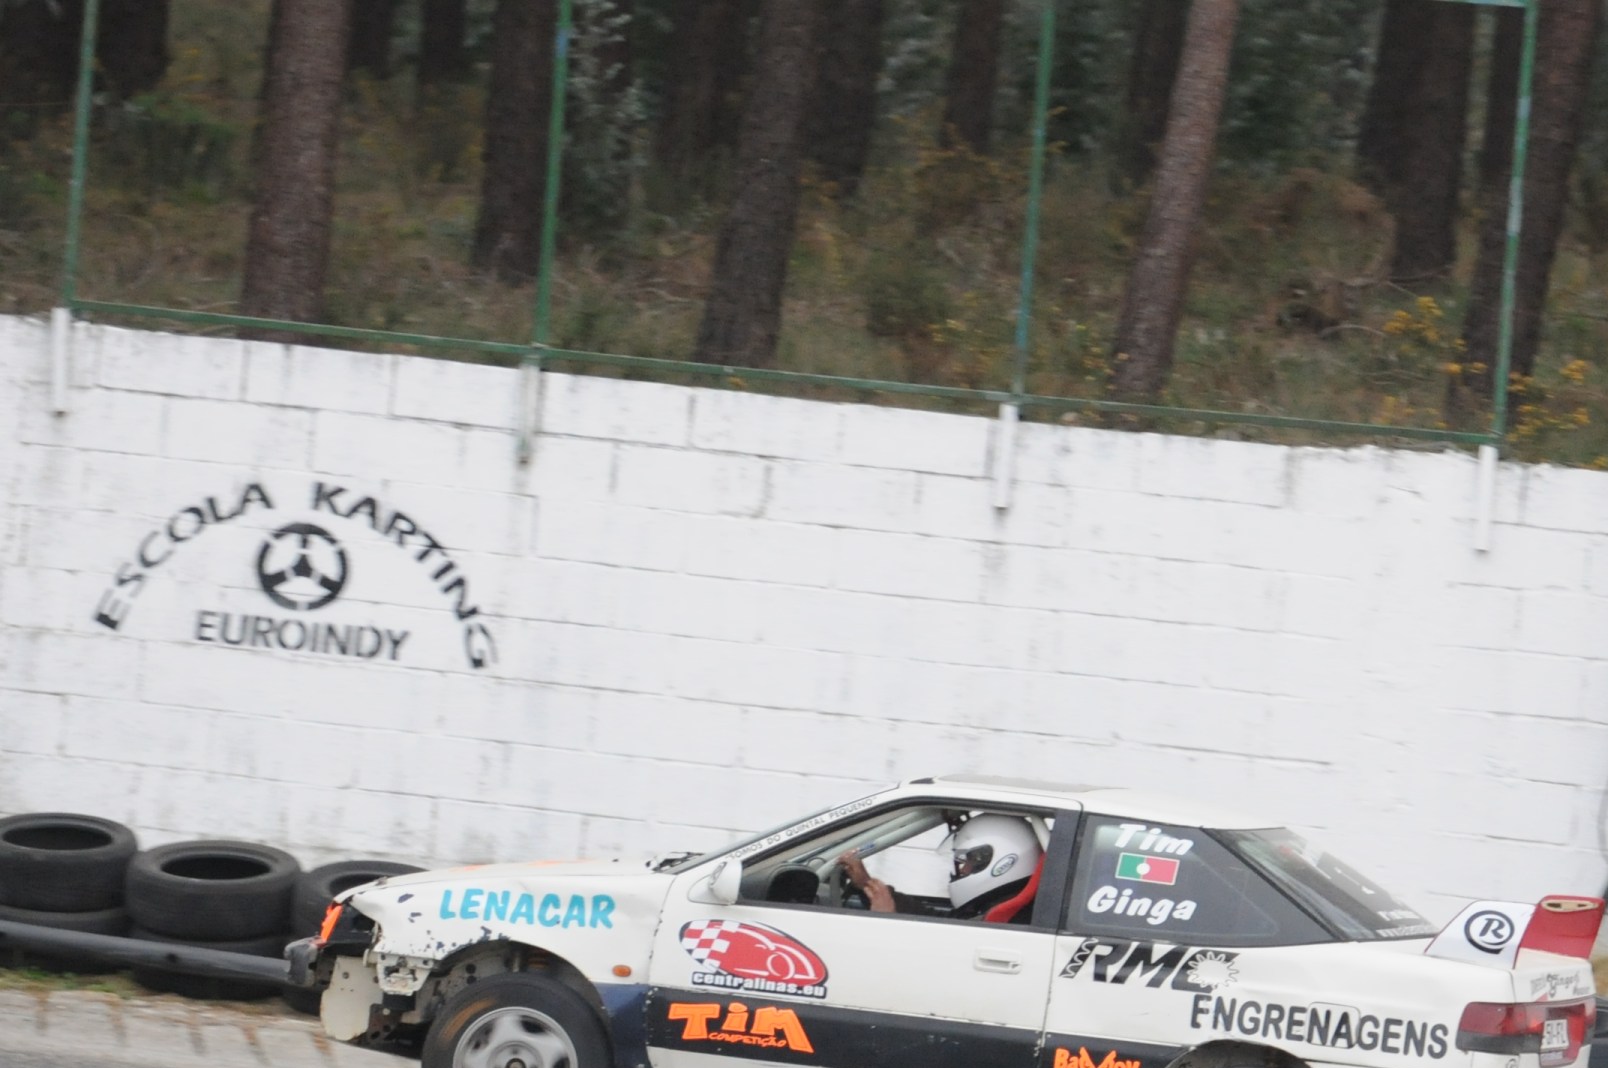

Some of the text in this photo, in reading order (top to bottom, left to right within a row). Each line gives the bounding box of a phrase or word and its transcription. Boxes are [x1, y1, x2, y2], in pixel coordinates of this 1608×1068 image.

[93, 481, 499, 669] ESCOLA KARTING
[194, 610, 410, 661] EUROINDY
[767, 834, 782, 845] DO
[785, 817, 827, 838] QUINTAL
[1114, 823, 1195, 856] Tim
[439, 887, 617, 930] LENACAR
[1087, 885, 1198, 926] Ginga
[692, 972, 826, 998] centralinas.eu
[1190, 992, 1449, 1060] ENGRENAGENS
